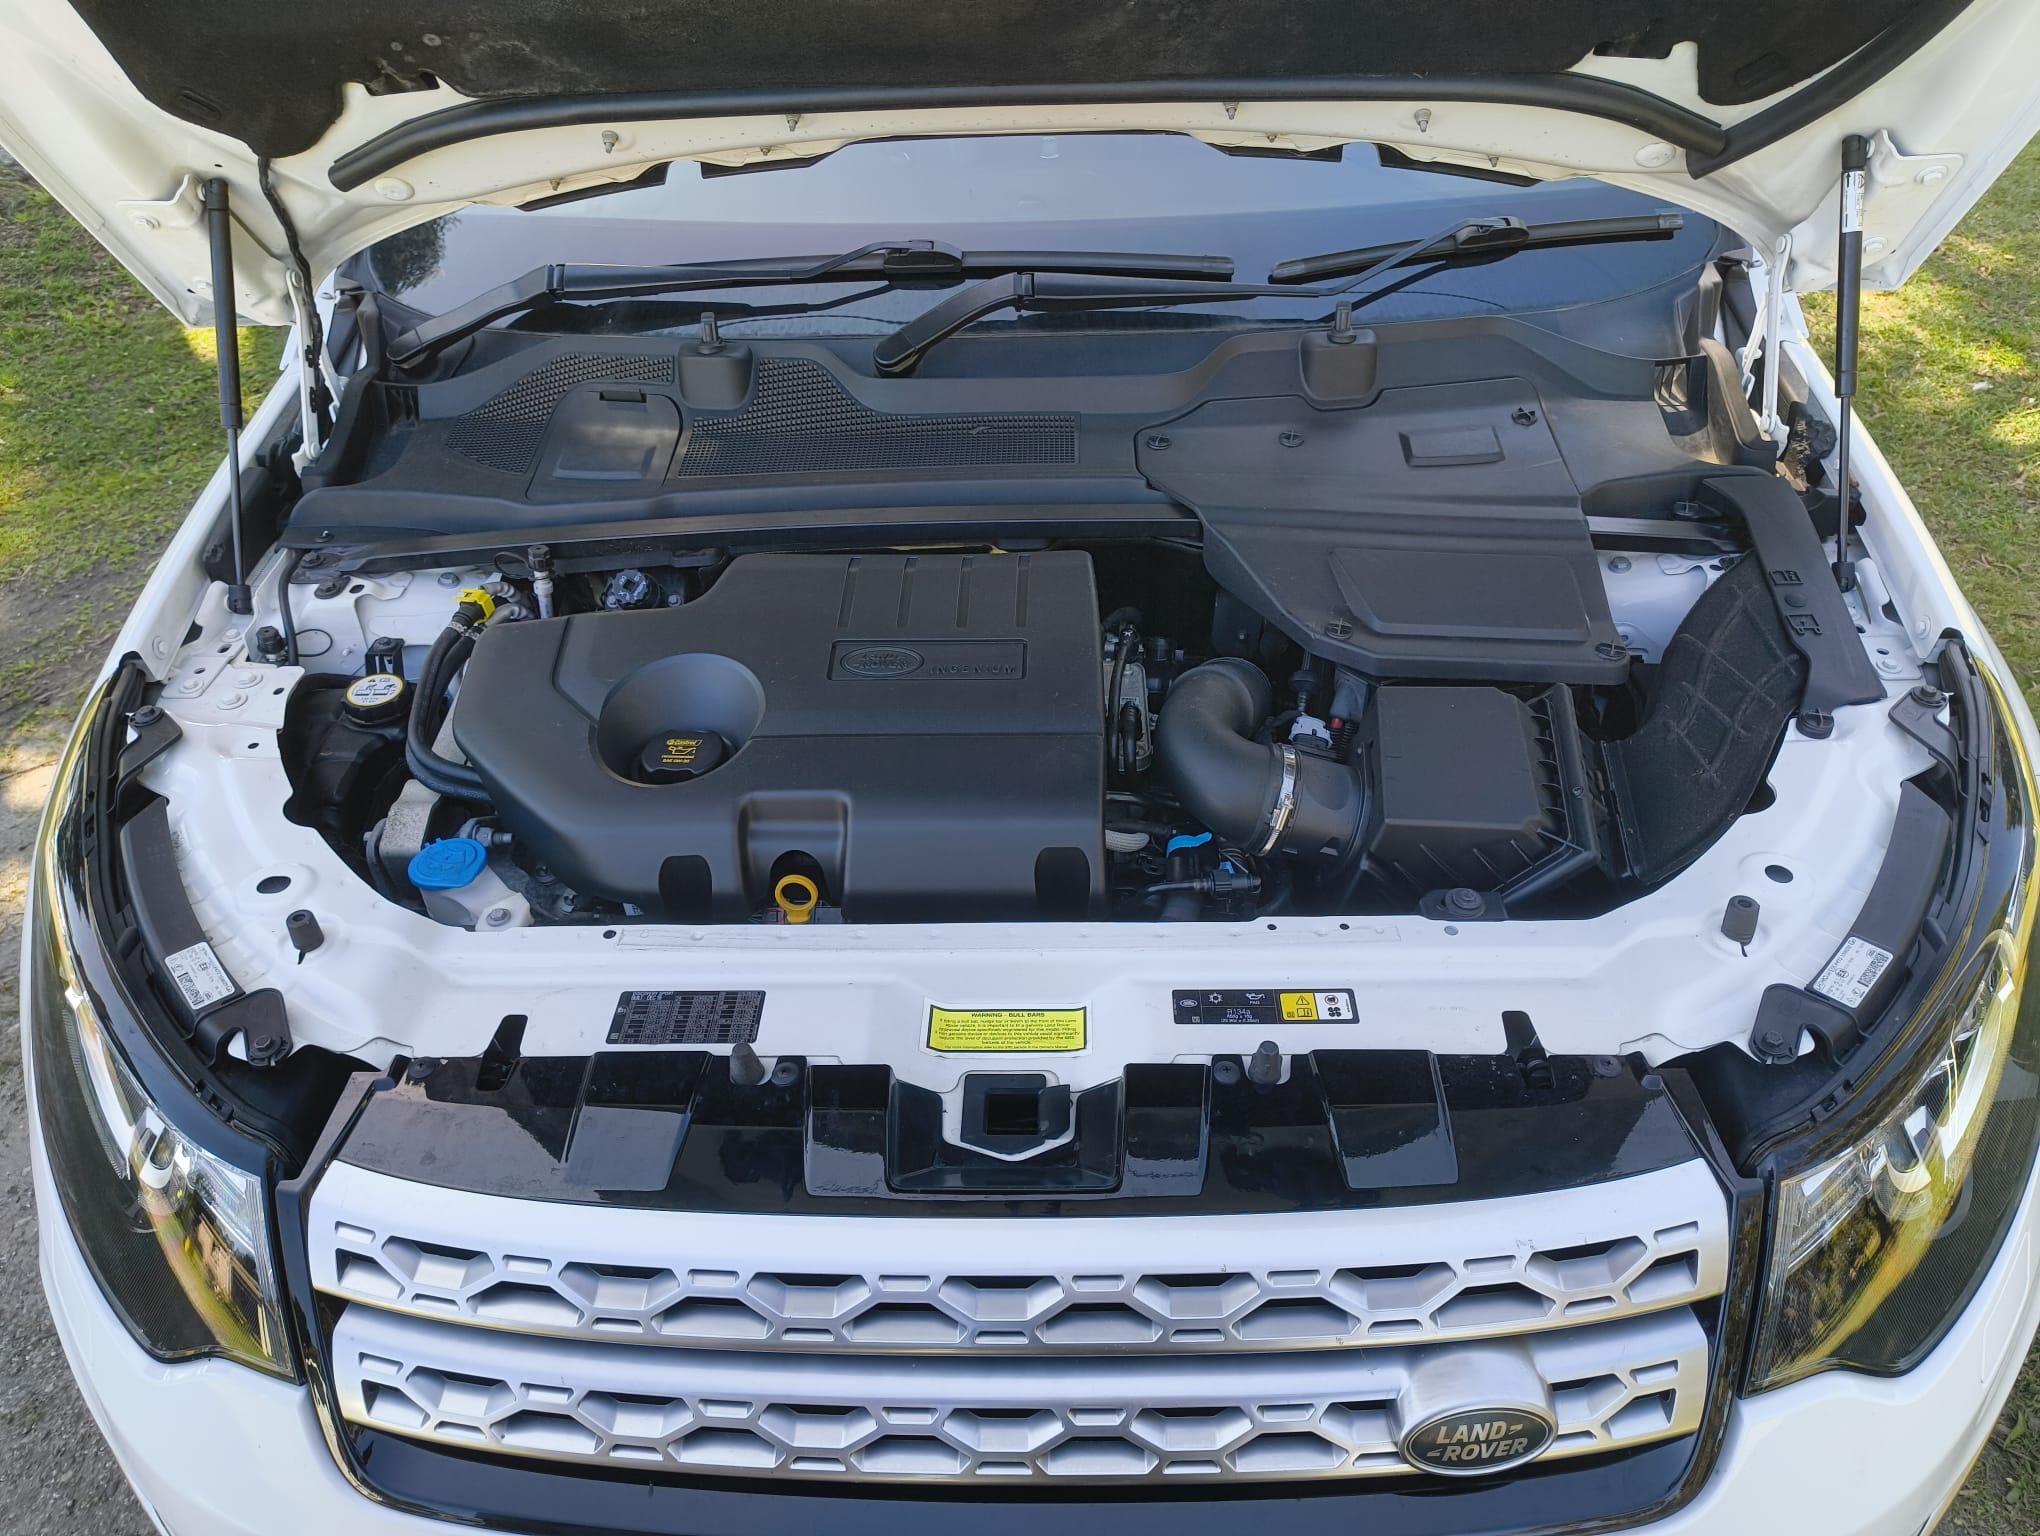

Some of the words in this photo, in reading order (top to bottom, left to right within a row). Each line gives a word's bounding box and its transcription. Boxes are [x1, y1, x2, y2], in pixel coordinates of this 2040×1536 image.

[929, 664, 1017, 674] INGENIUM
[1436, 1421, 1506, 1444] LAND
[1442, 1438, 1528, 1461] ROVER
